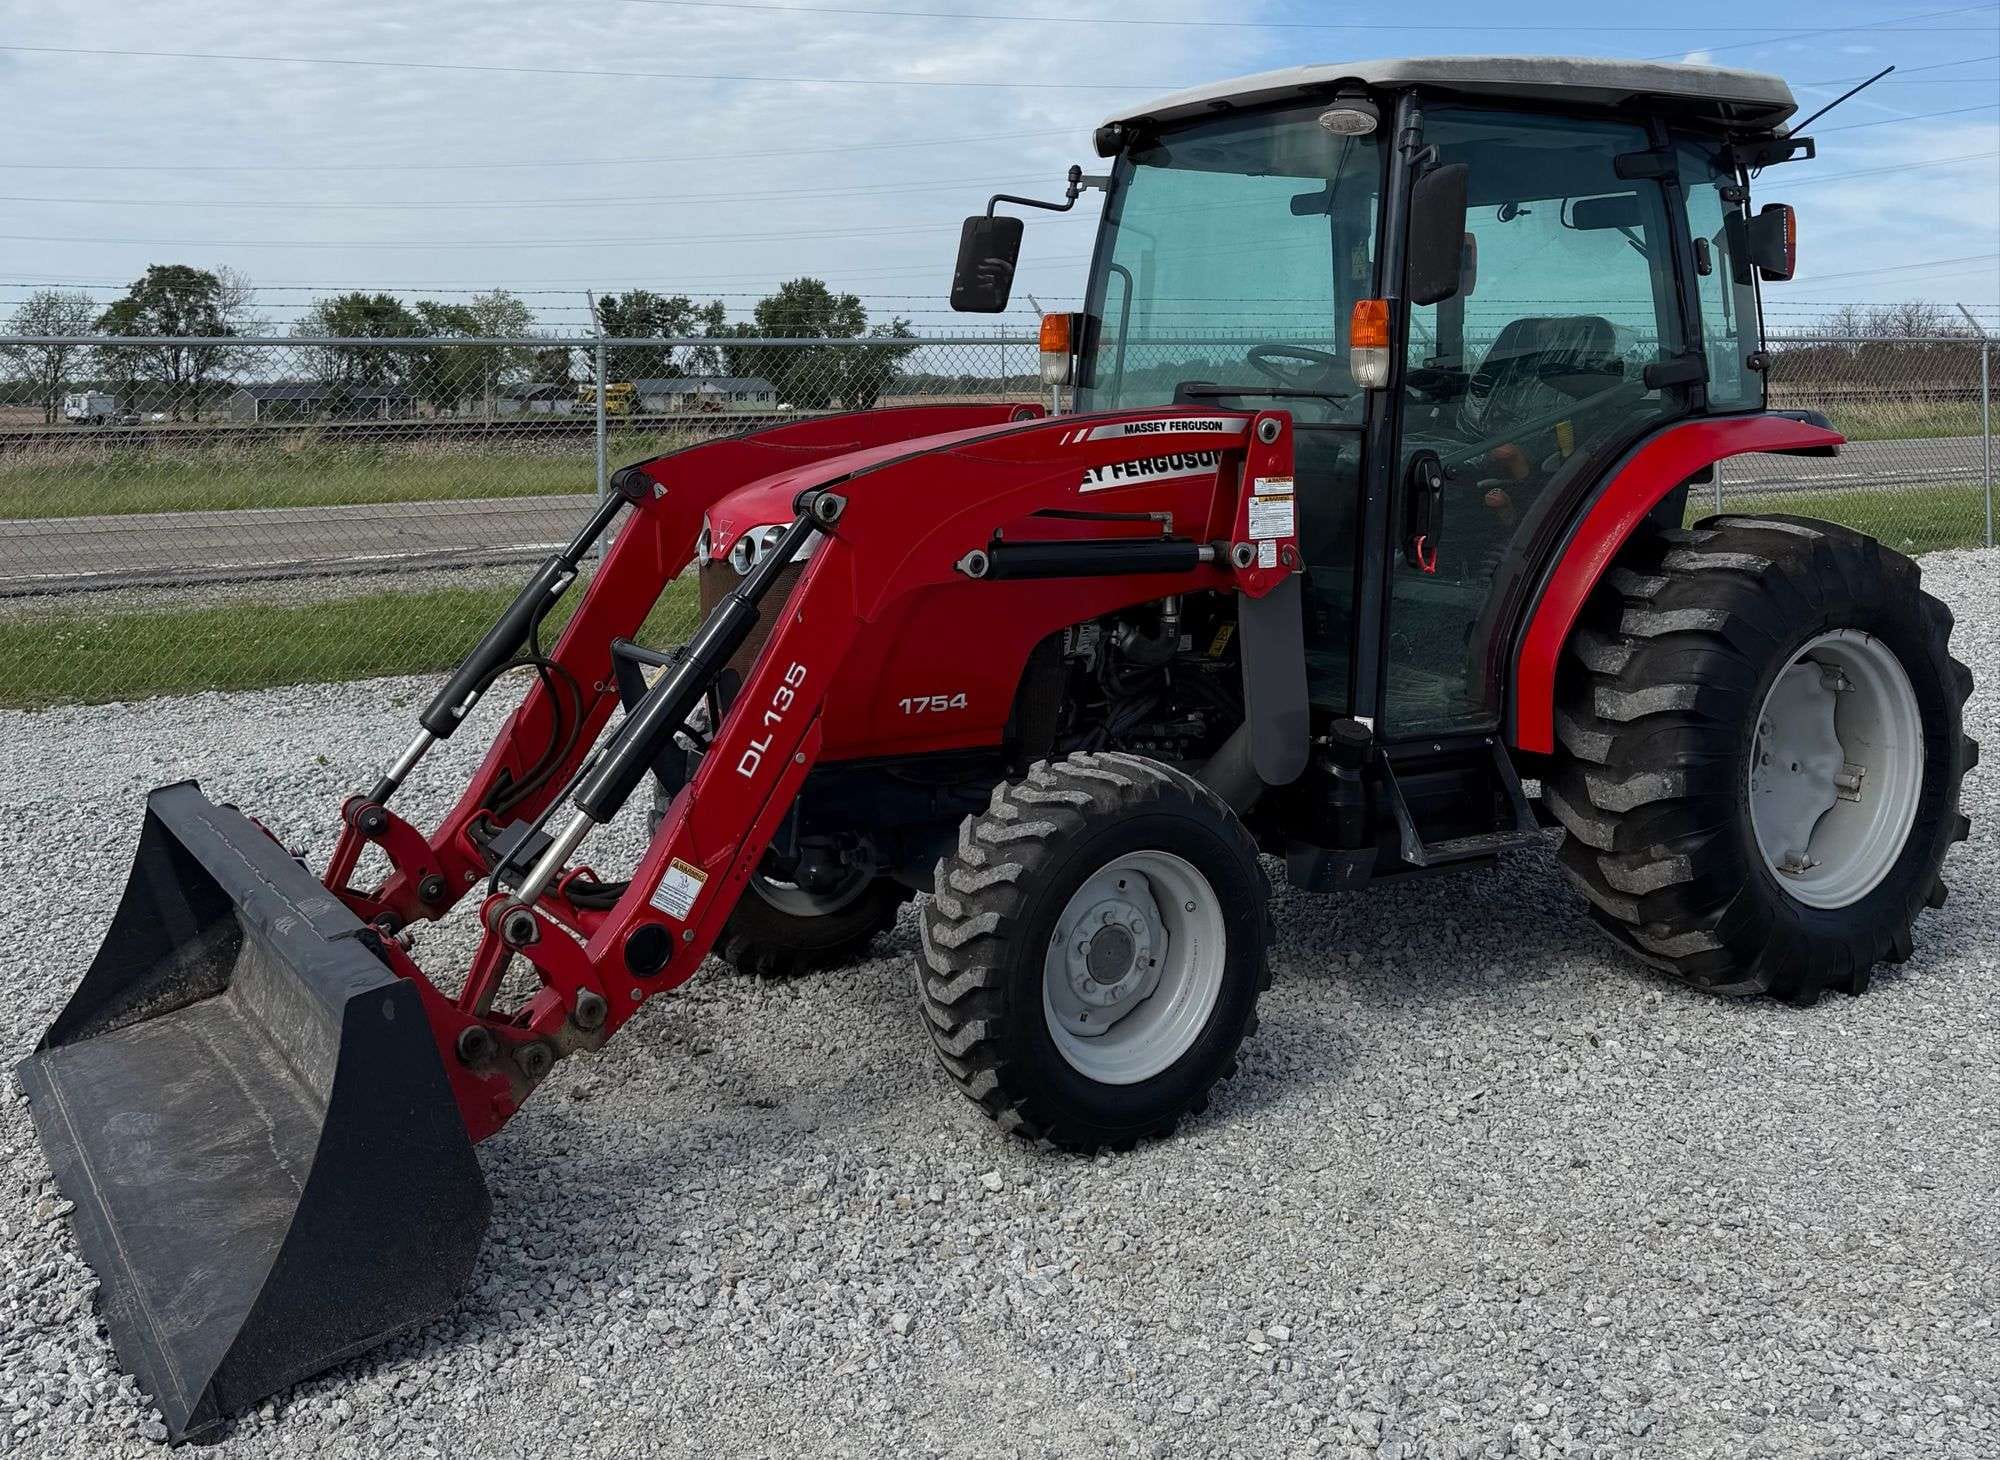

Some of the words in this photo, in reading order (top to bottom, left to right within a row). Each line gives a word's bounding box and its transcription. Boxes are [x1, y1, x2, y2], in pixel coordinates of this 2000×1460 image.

[1124, 422, 1167, 434] MASSEY
[1169, 421, 1223, 431] FERGUSON
[898, 693, 968, 714] 1754
[736, 734, 773, 778] DL
[764, 661, 807, 726] 135
